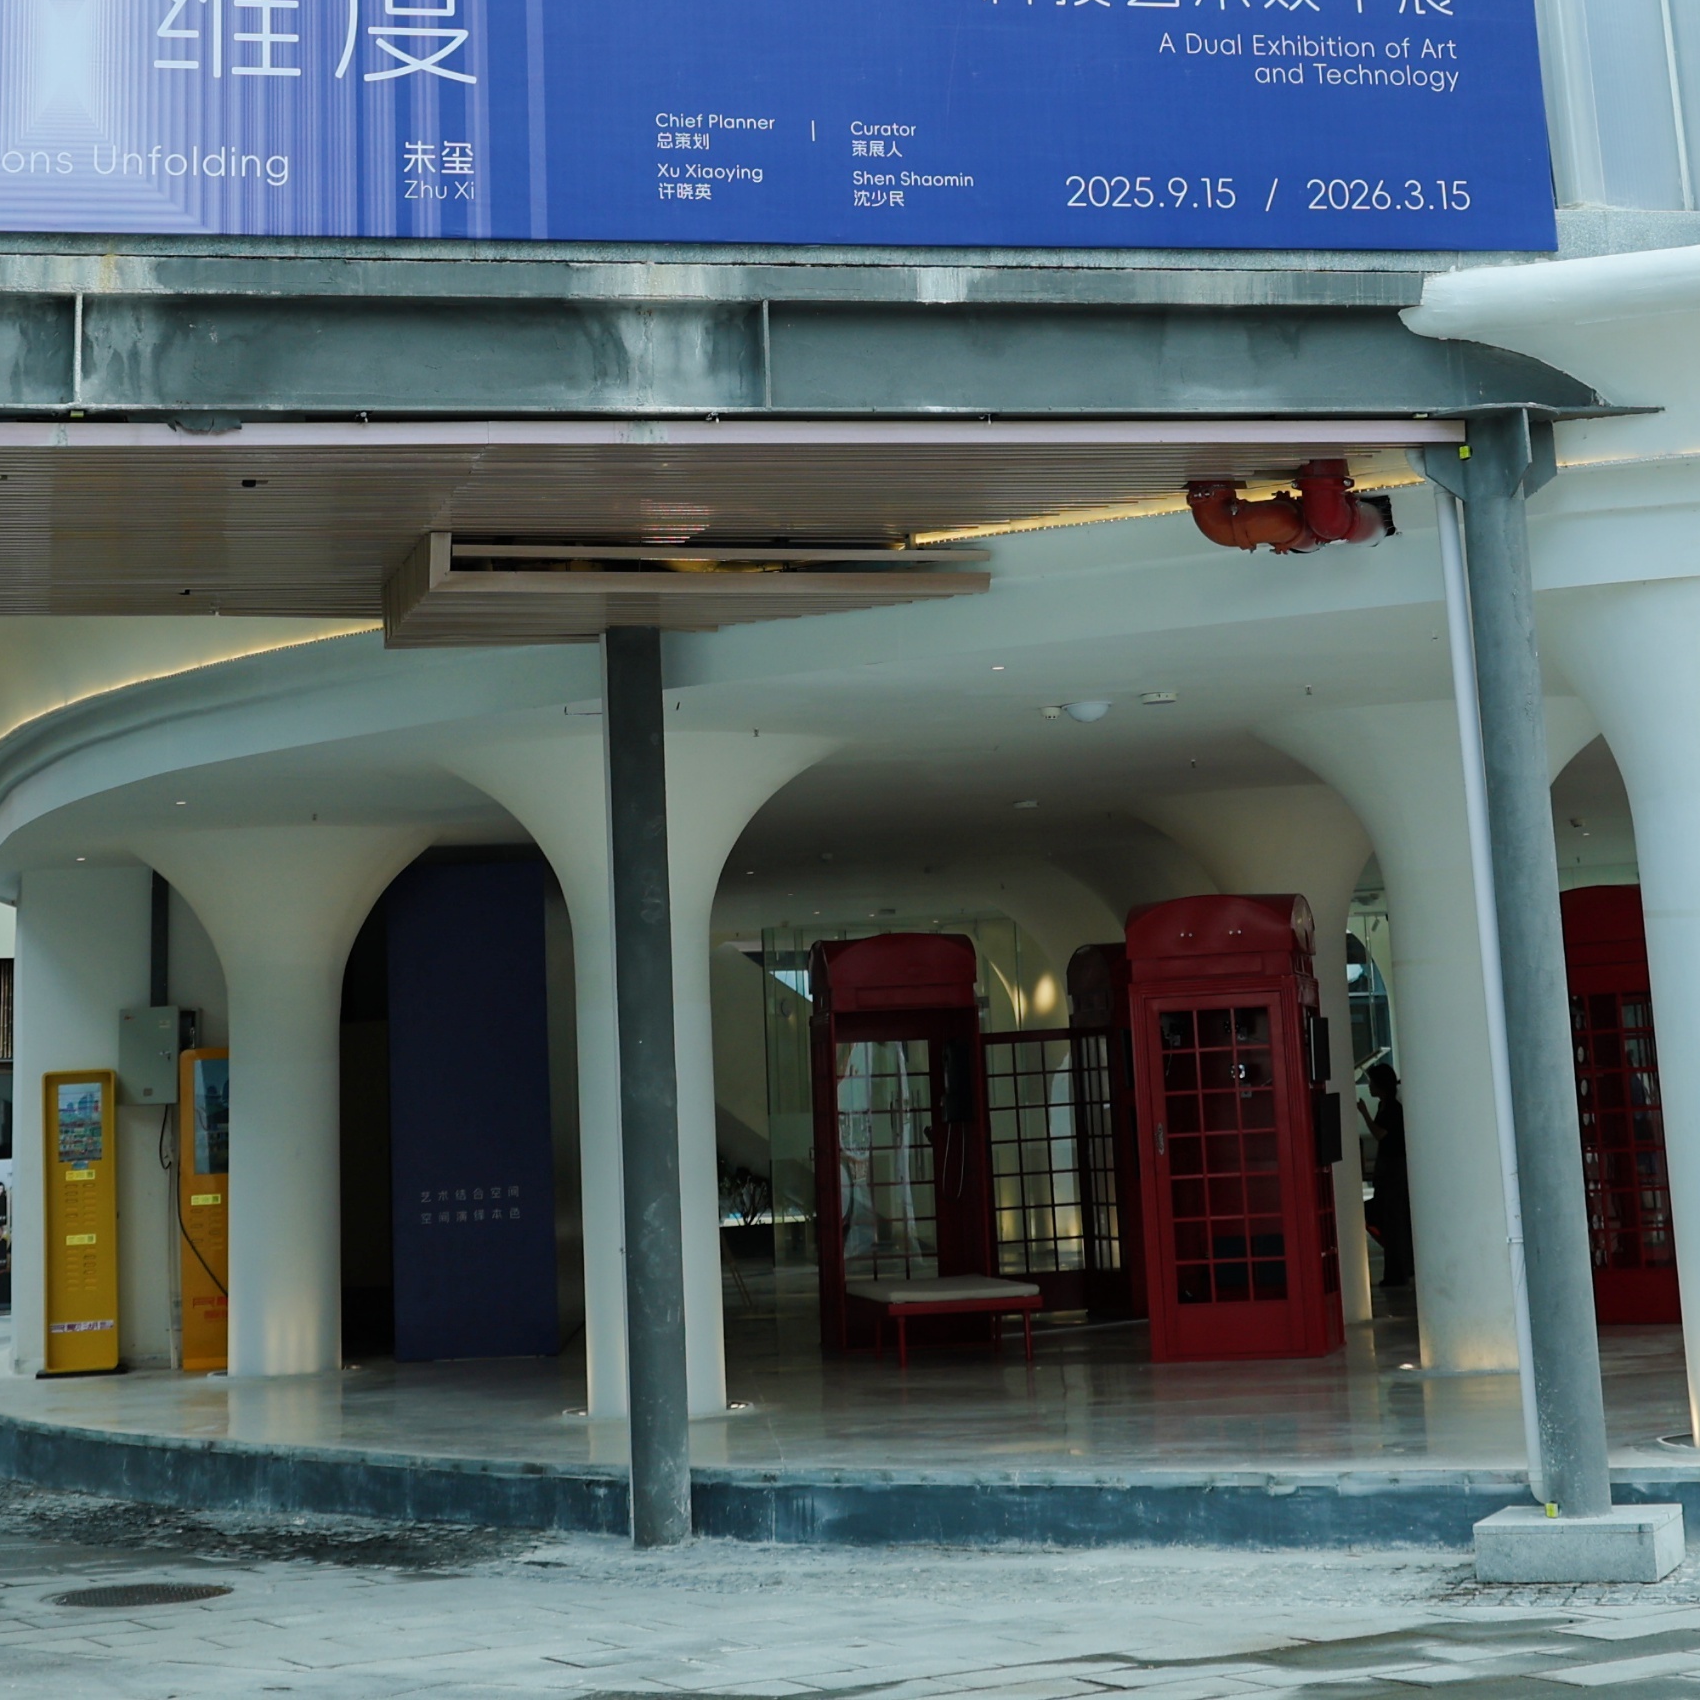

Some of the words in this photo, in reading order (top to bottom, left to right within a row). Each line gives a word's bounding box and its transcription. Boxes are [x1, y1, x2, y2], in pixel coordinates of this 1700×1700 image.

[1159, 33, 1175, 53] A
[1186, 33, 1241, 55] Dual
[1253, 35, 1375, 57] Exhibition
[1386, 38, 1410, 58] of
[1421, 39, 1457, 59] Art
[1255, 63, 1303, 84] and
[1313, 64, 1458, 92] Technology
[656, 113, 702, 128] Chief
[709, 114, 775, 129] Planner
[851, 121, 916, 136] Curator
[657, 132, 709, 149] 总策划
[852, 140, 902, 157] 策展人
[93, 143, 289, 185] Unfolding
[404, 140, 474, 174] 朱玺
[658, 164, 679, 177] Xu
[686, 164, 762, 183] Xiaoying
[853, 171, 895, 185] Shen
[901, 171, 973, 186] Shaomin
[405, 177, 447, 203] Zhu
[455, 181, 474, 199] Xi
[659, 183, 711, 200] 许晓英
[854, 190, 904, 206] 沈少民
[1066, 176, 1235, 208] 2025.9.15
[1307, 179, 1470, 210] 2026.3.15
